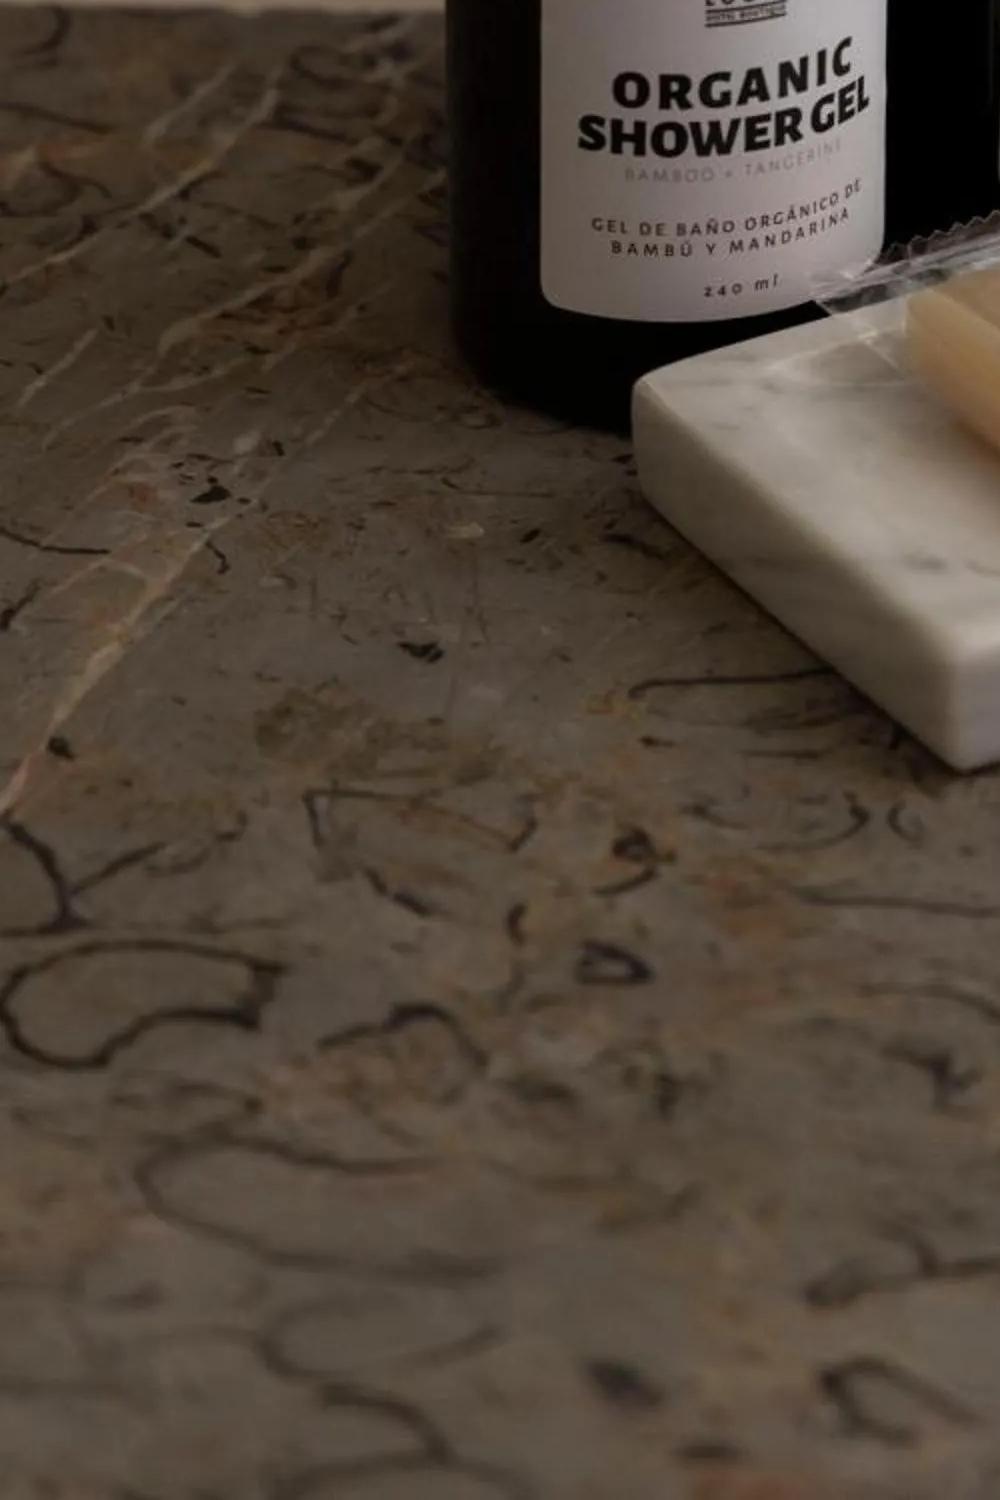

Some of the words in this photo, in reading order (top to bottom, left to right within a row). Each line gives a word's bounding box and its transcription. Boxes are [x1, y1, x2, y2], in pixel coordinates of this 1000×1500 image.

[612, 36, 853, 110] ORGANIC
[578, 106, 803, 158] SHOWER
[810, 75, 870, 133] GEL
[625, 165, 716, 183] BAMBOO
[591, 217, 628, 235] GEL
[639, 221, 667, 237] DE
[676, 218, 736, 237] BAÑO
[744, 192, 839, 232] ORGÁNICO
[844, 178, 862, 199] DE
[611, 239, 693, 257] BAMBÚ
[706, 243, 717, 255] Y
[729, 207, 850, 255] MANDARINA
[703, 282, 743, 298] 240
[754, 273, 780, 292] ml
